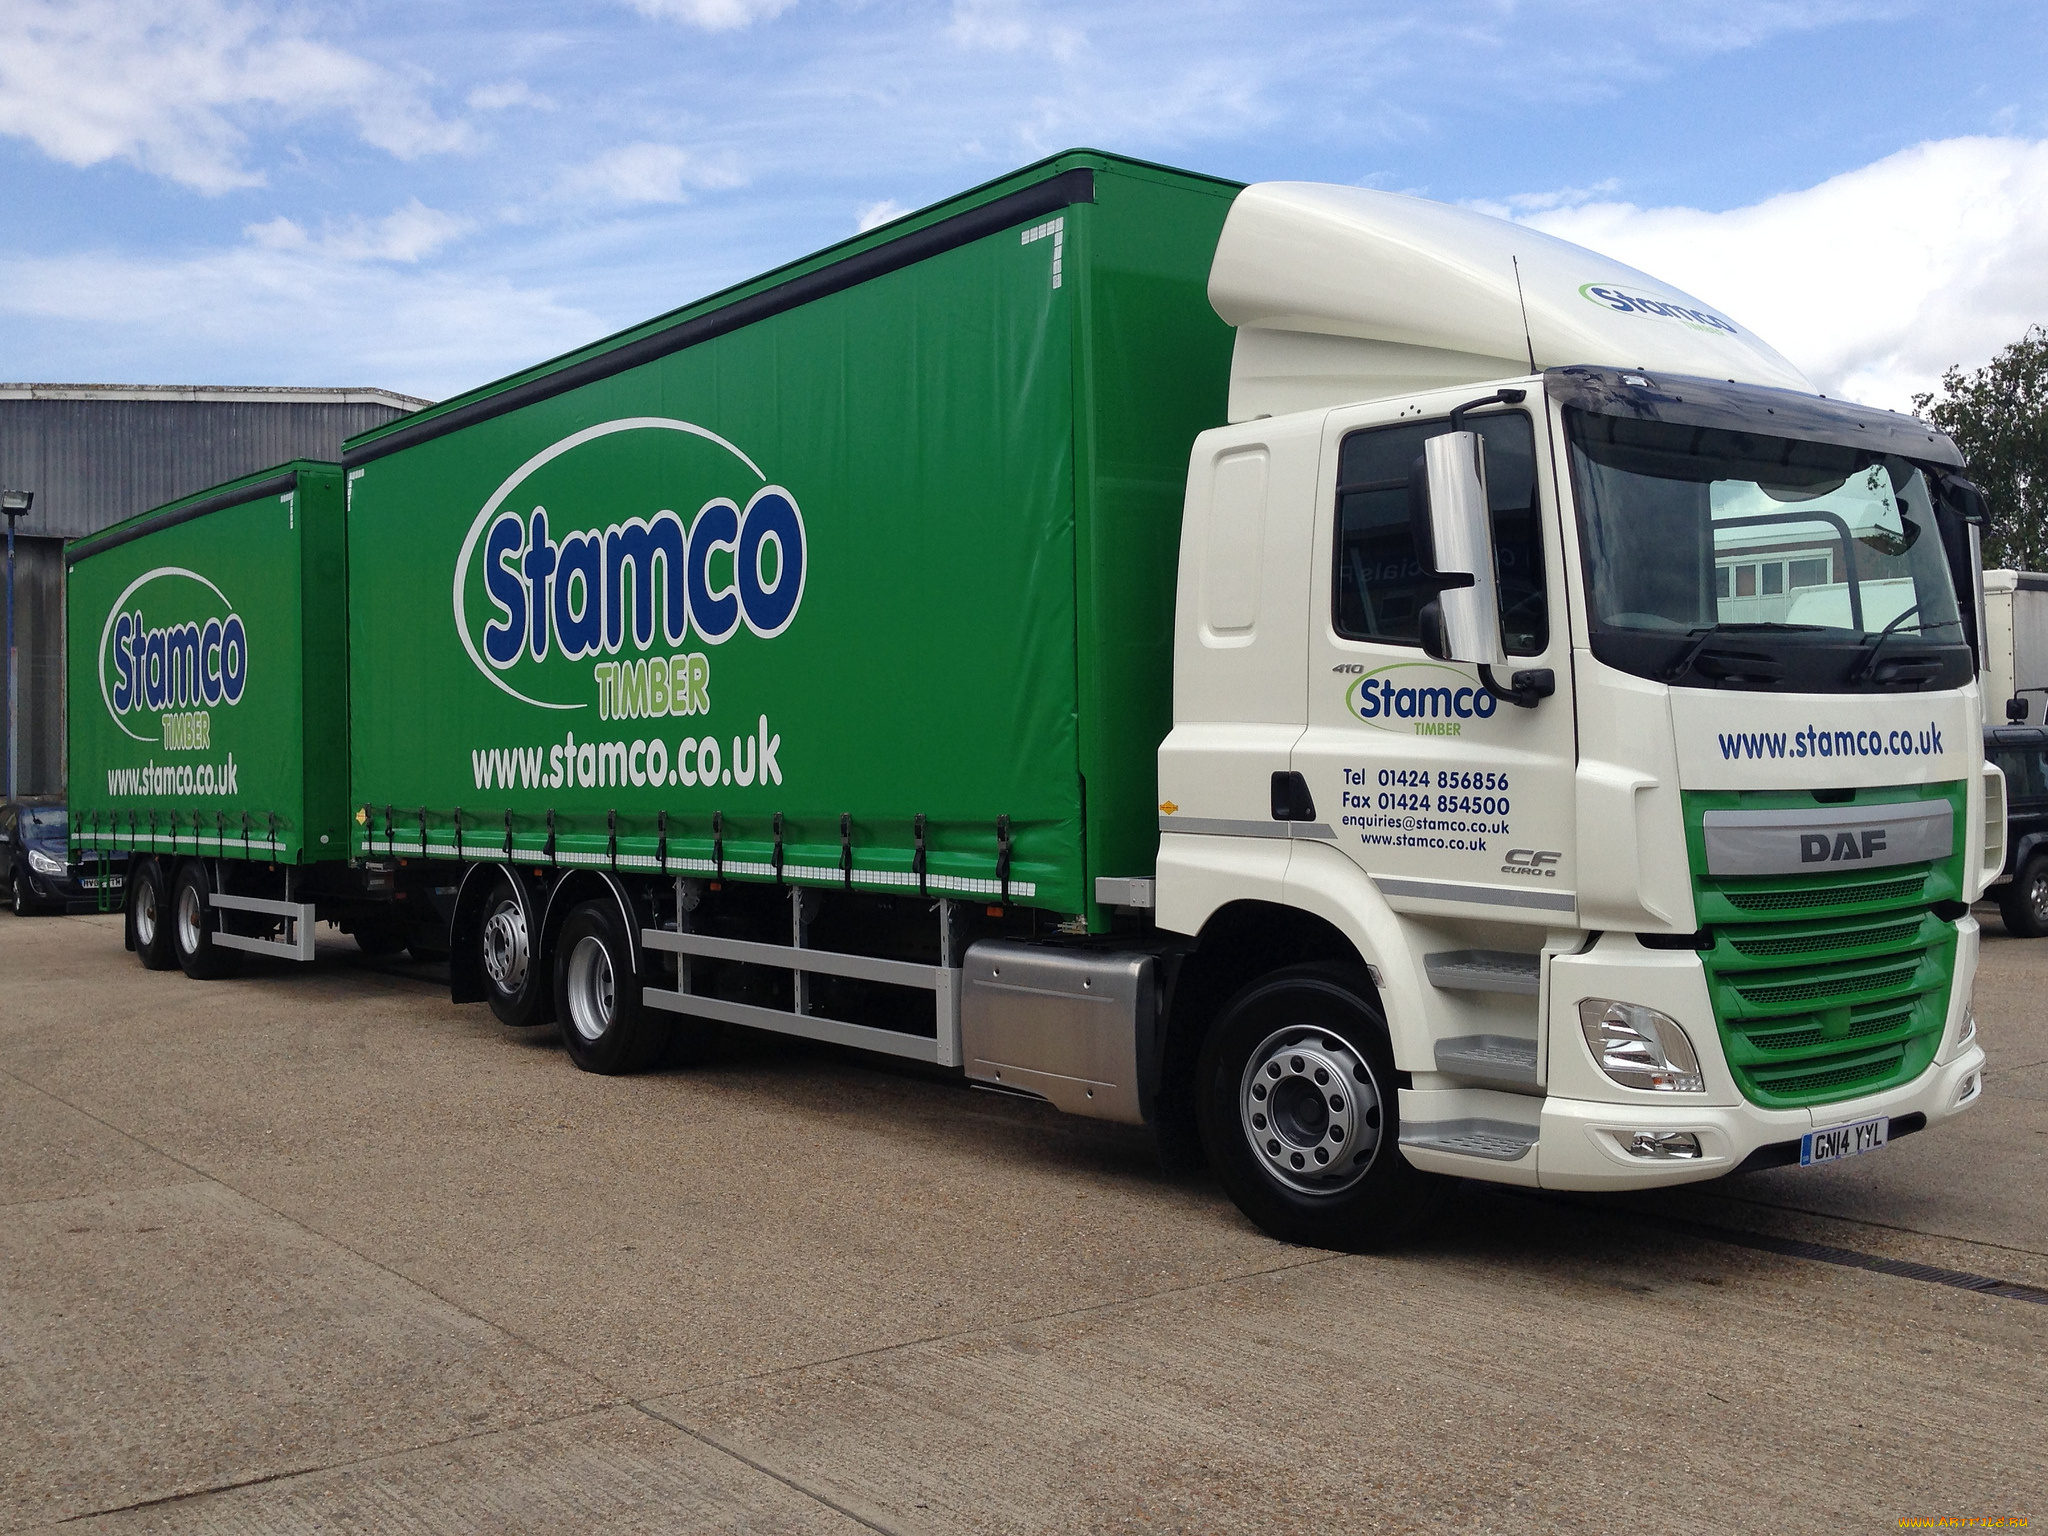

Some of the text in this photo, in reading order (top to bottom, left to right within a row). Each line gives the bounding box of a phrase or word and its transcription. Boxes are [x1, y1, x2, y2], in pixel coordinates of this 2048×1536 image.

[1591, 287, 1738, 334] Stamco
[484, 485, 807, 669] Stamco
[113, 609, 248, 715] Stamco
[1332, 663, 1365, 674] 410
[595, 653, 710, 720] TIMBER
[1360, 678, 1498, 719] Stamco
[162, 711, 210, 750] TIMBER
[1414, 722, 1461, 736] TIMBER
[1718, 721, 1944, 760] www.stamco.co.uk
[472, 714, 782, 790] www.stamco.co.uk
[107, 752, 238, 796] www.stamco.co.uk
[1343, 768, 1510, 791] Tel 01424 856856
[1342, 791, 1510, 816] Fax 01424 854500
[1342, 814, 1509, 834] enquiries@stamco.co.uk
[1361, 834, 1487, 851] www.stamco.co.uk
[1504, 848, 1562, 866] CF
[1800, 829, 1887, 863] DAF
[1500, 865, 1556, 877] EURO 6
[1815, 1123, 1882, 1159] GN14 YYL
